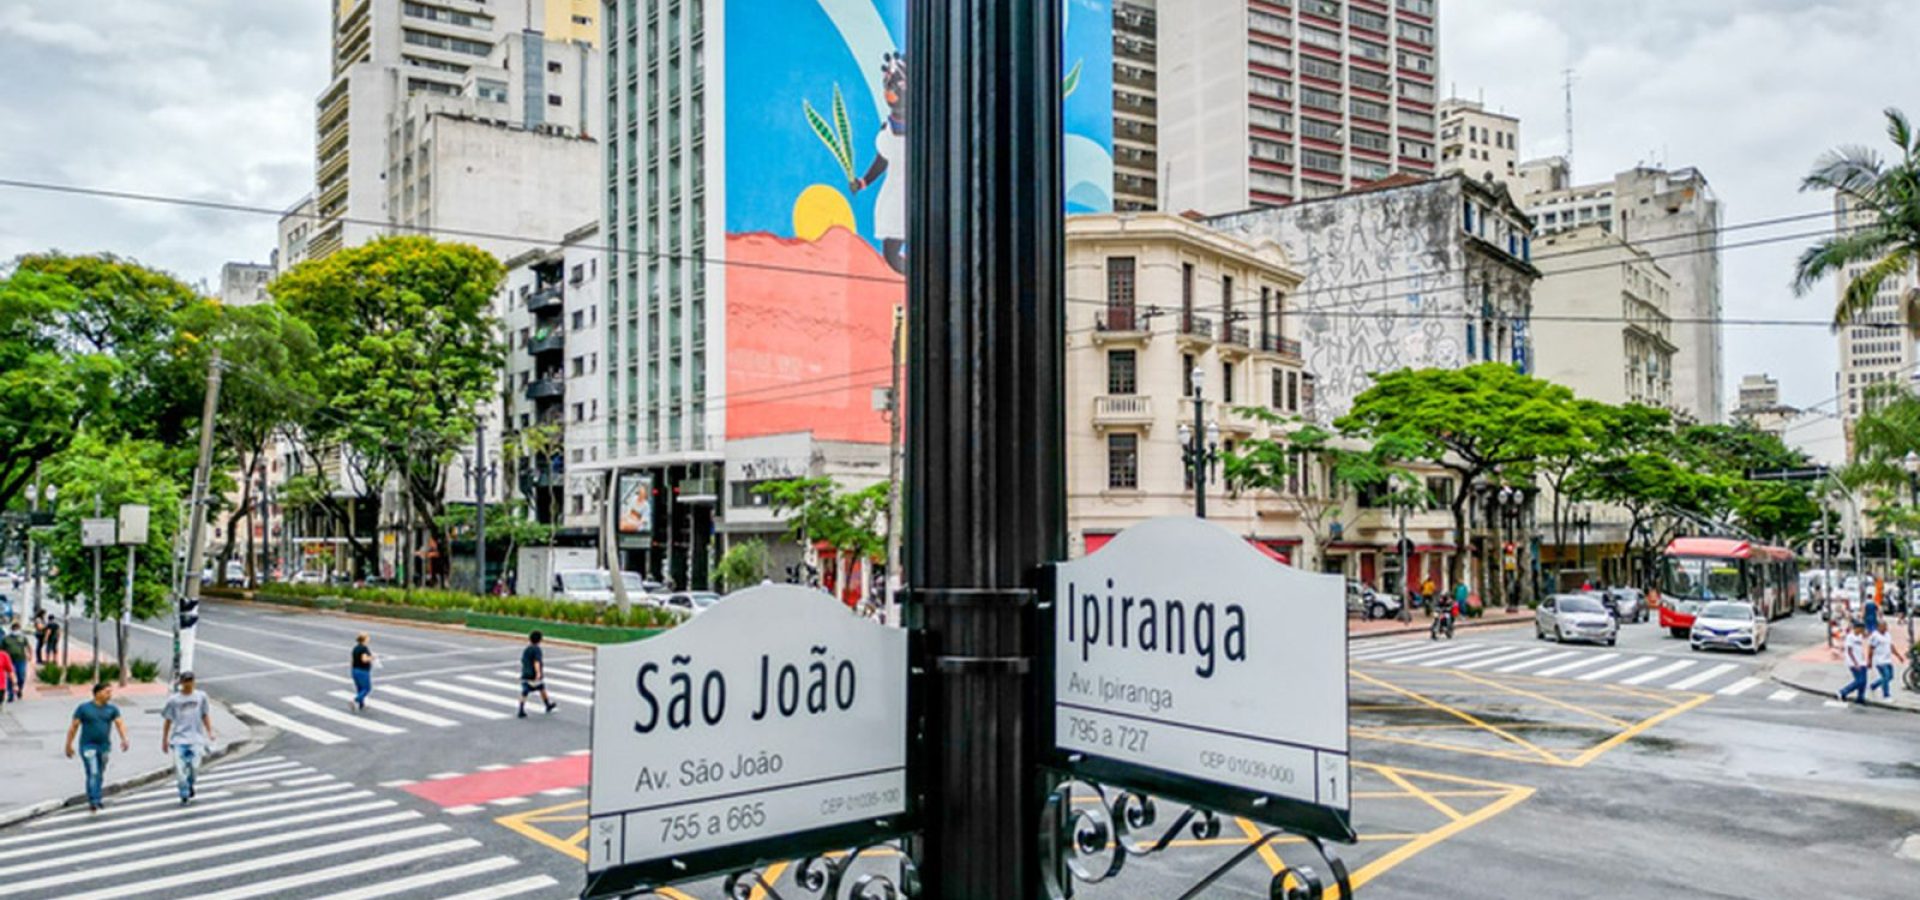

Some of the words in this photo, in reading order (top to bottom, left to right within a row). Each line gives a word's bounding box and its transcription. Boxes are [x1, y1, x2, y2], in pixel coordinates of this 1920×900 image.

[1068, 578, 1246, 678] Ipiranga
[634, 655, 727, 734] São
[751, 645, 856, 721] João
[1068, 672, 1093, 696] Av.
[1098, 676, 1172, 712] Ipiranga
[1069, 716, 1098, 743] 795
[1103, 727, 1113, 746] a
[1118, 725, 1149, 752] 727
[635, 766, 671, 793] Av.
[679, 758, 724, 787] São
[730, 750, 783, 780] João
[1200, 750, 1225, 769] CEP
[1330, 776, 1337, 800] 1
[660, 812, 701, 843] 755
[707, 815, 721, 836] a
[726, 802, 766, 832] 665
[604, 838, 611, 861] 1
